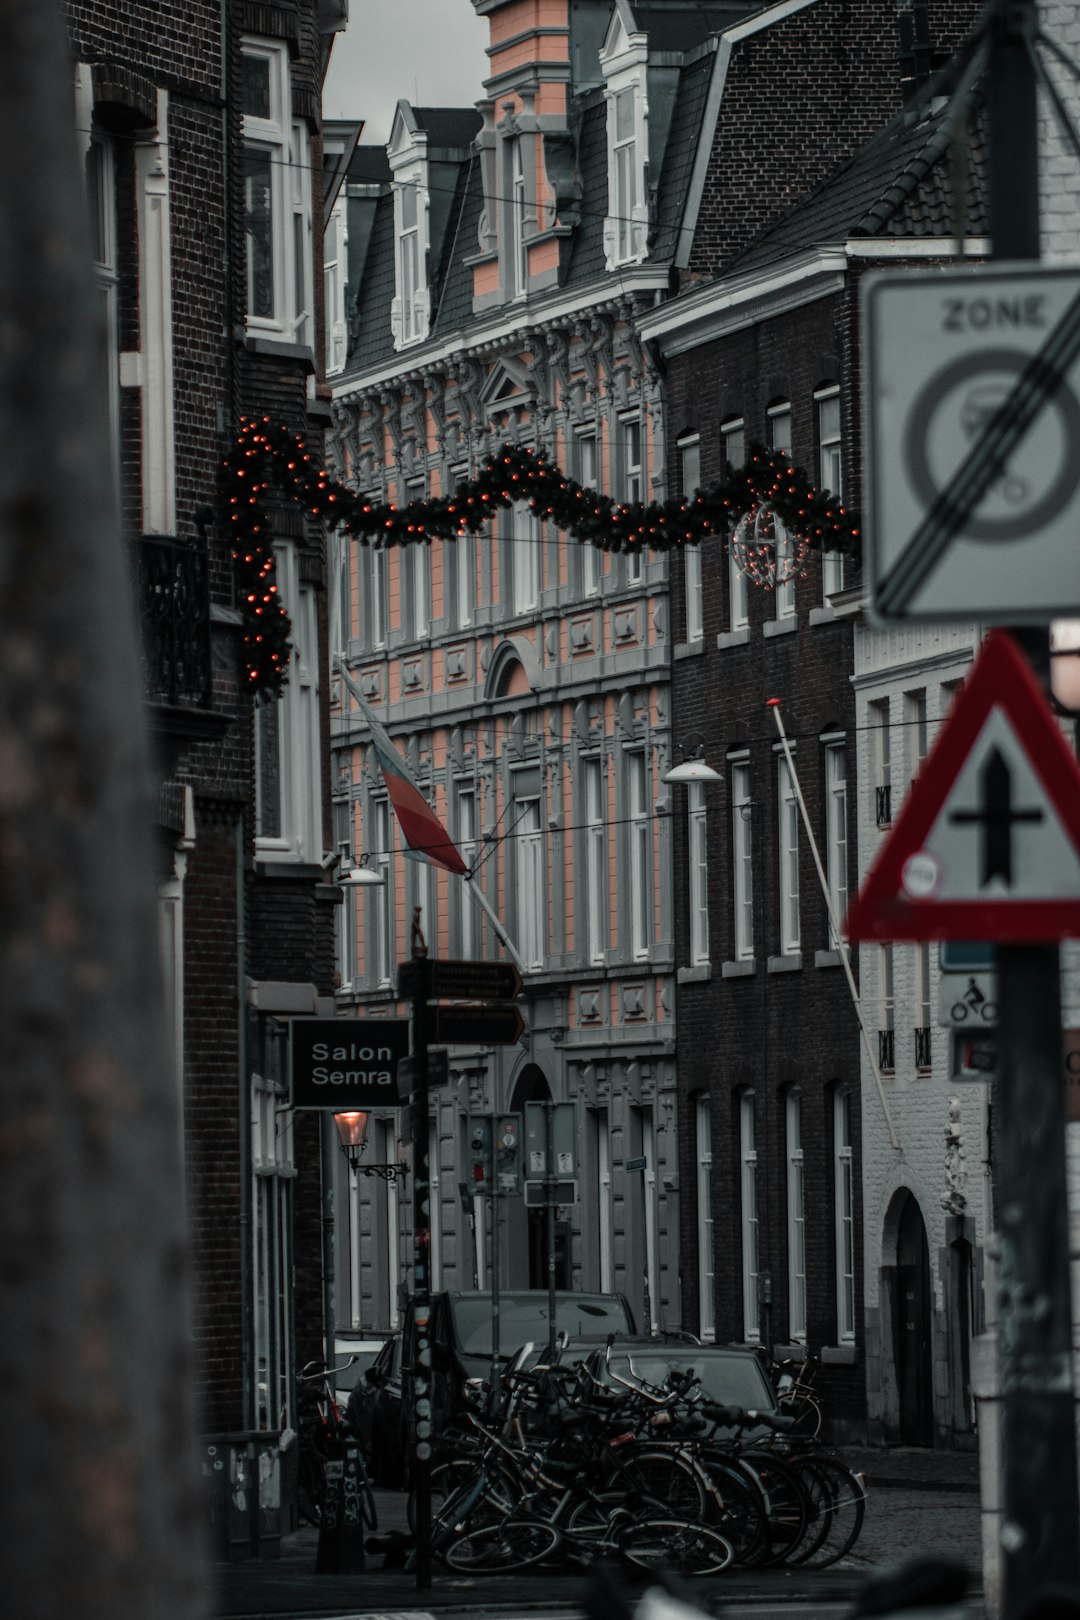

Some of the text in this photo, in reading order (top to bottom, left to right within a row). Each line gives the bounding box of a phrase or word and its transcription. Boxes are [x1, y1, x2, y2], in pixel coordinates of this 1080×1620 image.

[942, 295, 1046, 332] ZONE
[311, 1042, 391, 1061] Salon
[311, 1067, 391, 1085] Semra
